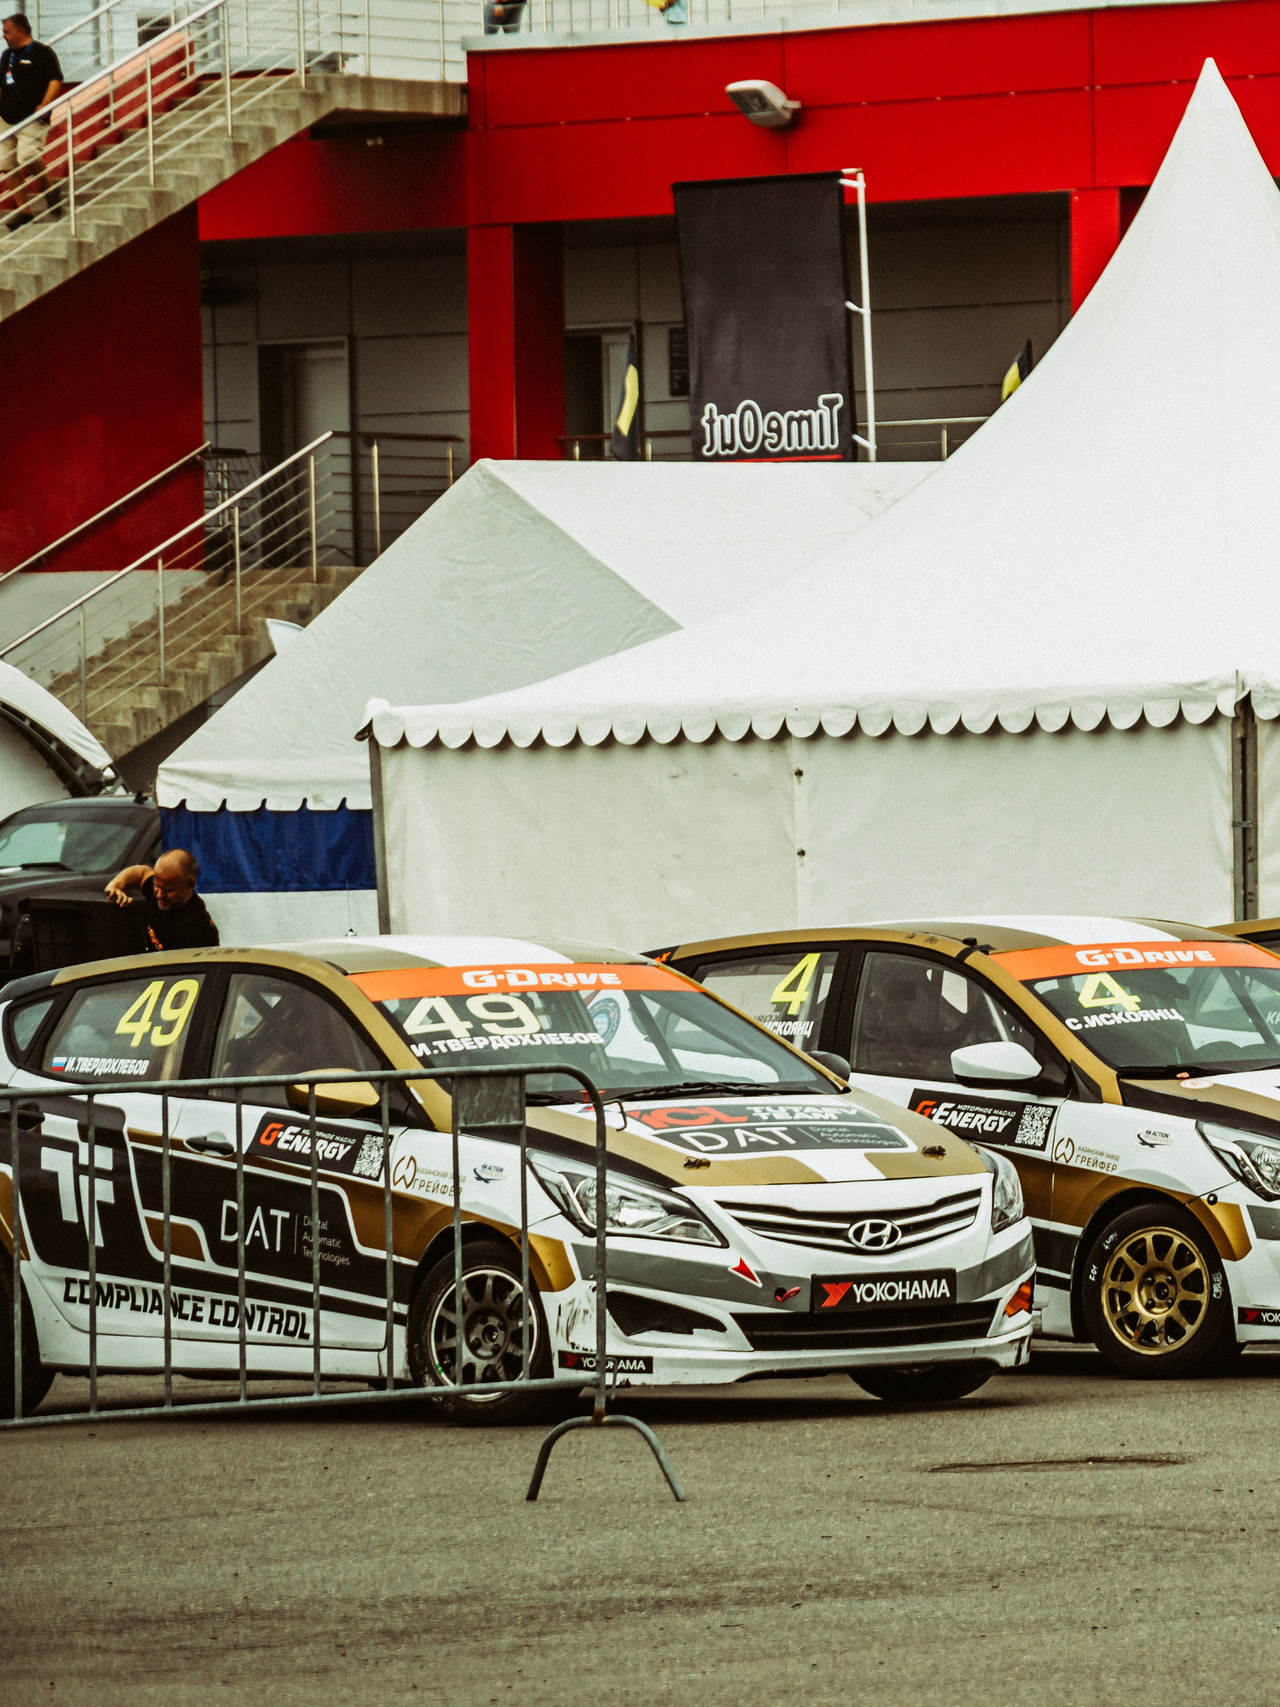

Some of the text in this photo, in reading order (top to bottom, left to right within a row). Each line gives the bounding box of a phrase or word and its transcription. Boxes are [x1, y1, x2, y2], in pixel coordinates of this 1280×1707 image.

[770, 952, 821, 1016] 4
[1078, 972, 1141, 1012] 4
[115, 978, 200, 1048] 49
[402, 994, 542, 1038] 49
[410, 1032, 605, 1058] И.ТВЕРДОХЛЕБОВ
[64, 1056, 150, 1077] И.ТВЕРДОХЛЕБОВ
[626, 1105, 748, 1129] ICL
[956, 1104, 993, 1114] МОТОРНОЕ
[680, 1126, 796, 1152] DAT
[1074, 1154, 1118, 1172] ГРЕЙФЕР
[220, 1199, 290, 1253] DAT
[852, 1278, 951, 1304] YOKOHAMA
[207, 1297, 311, 1341] CONTROL
